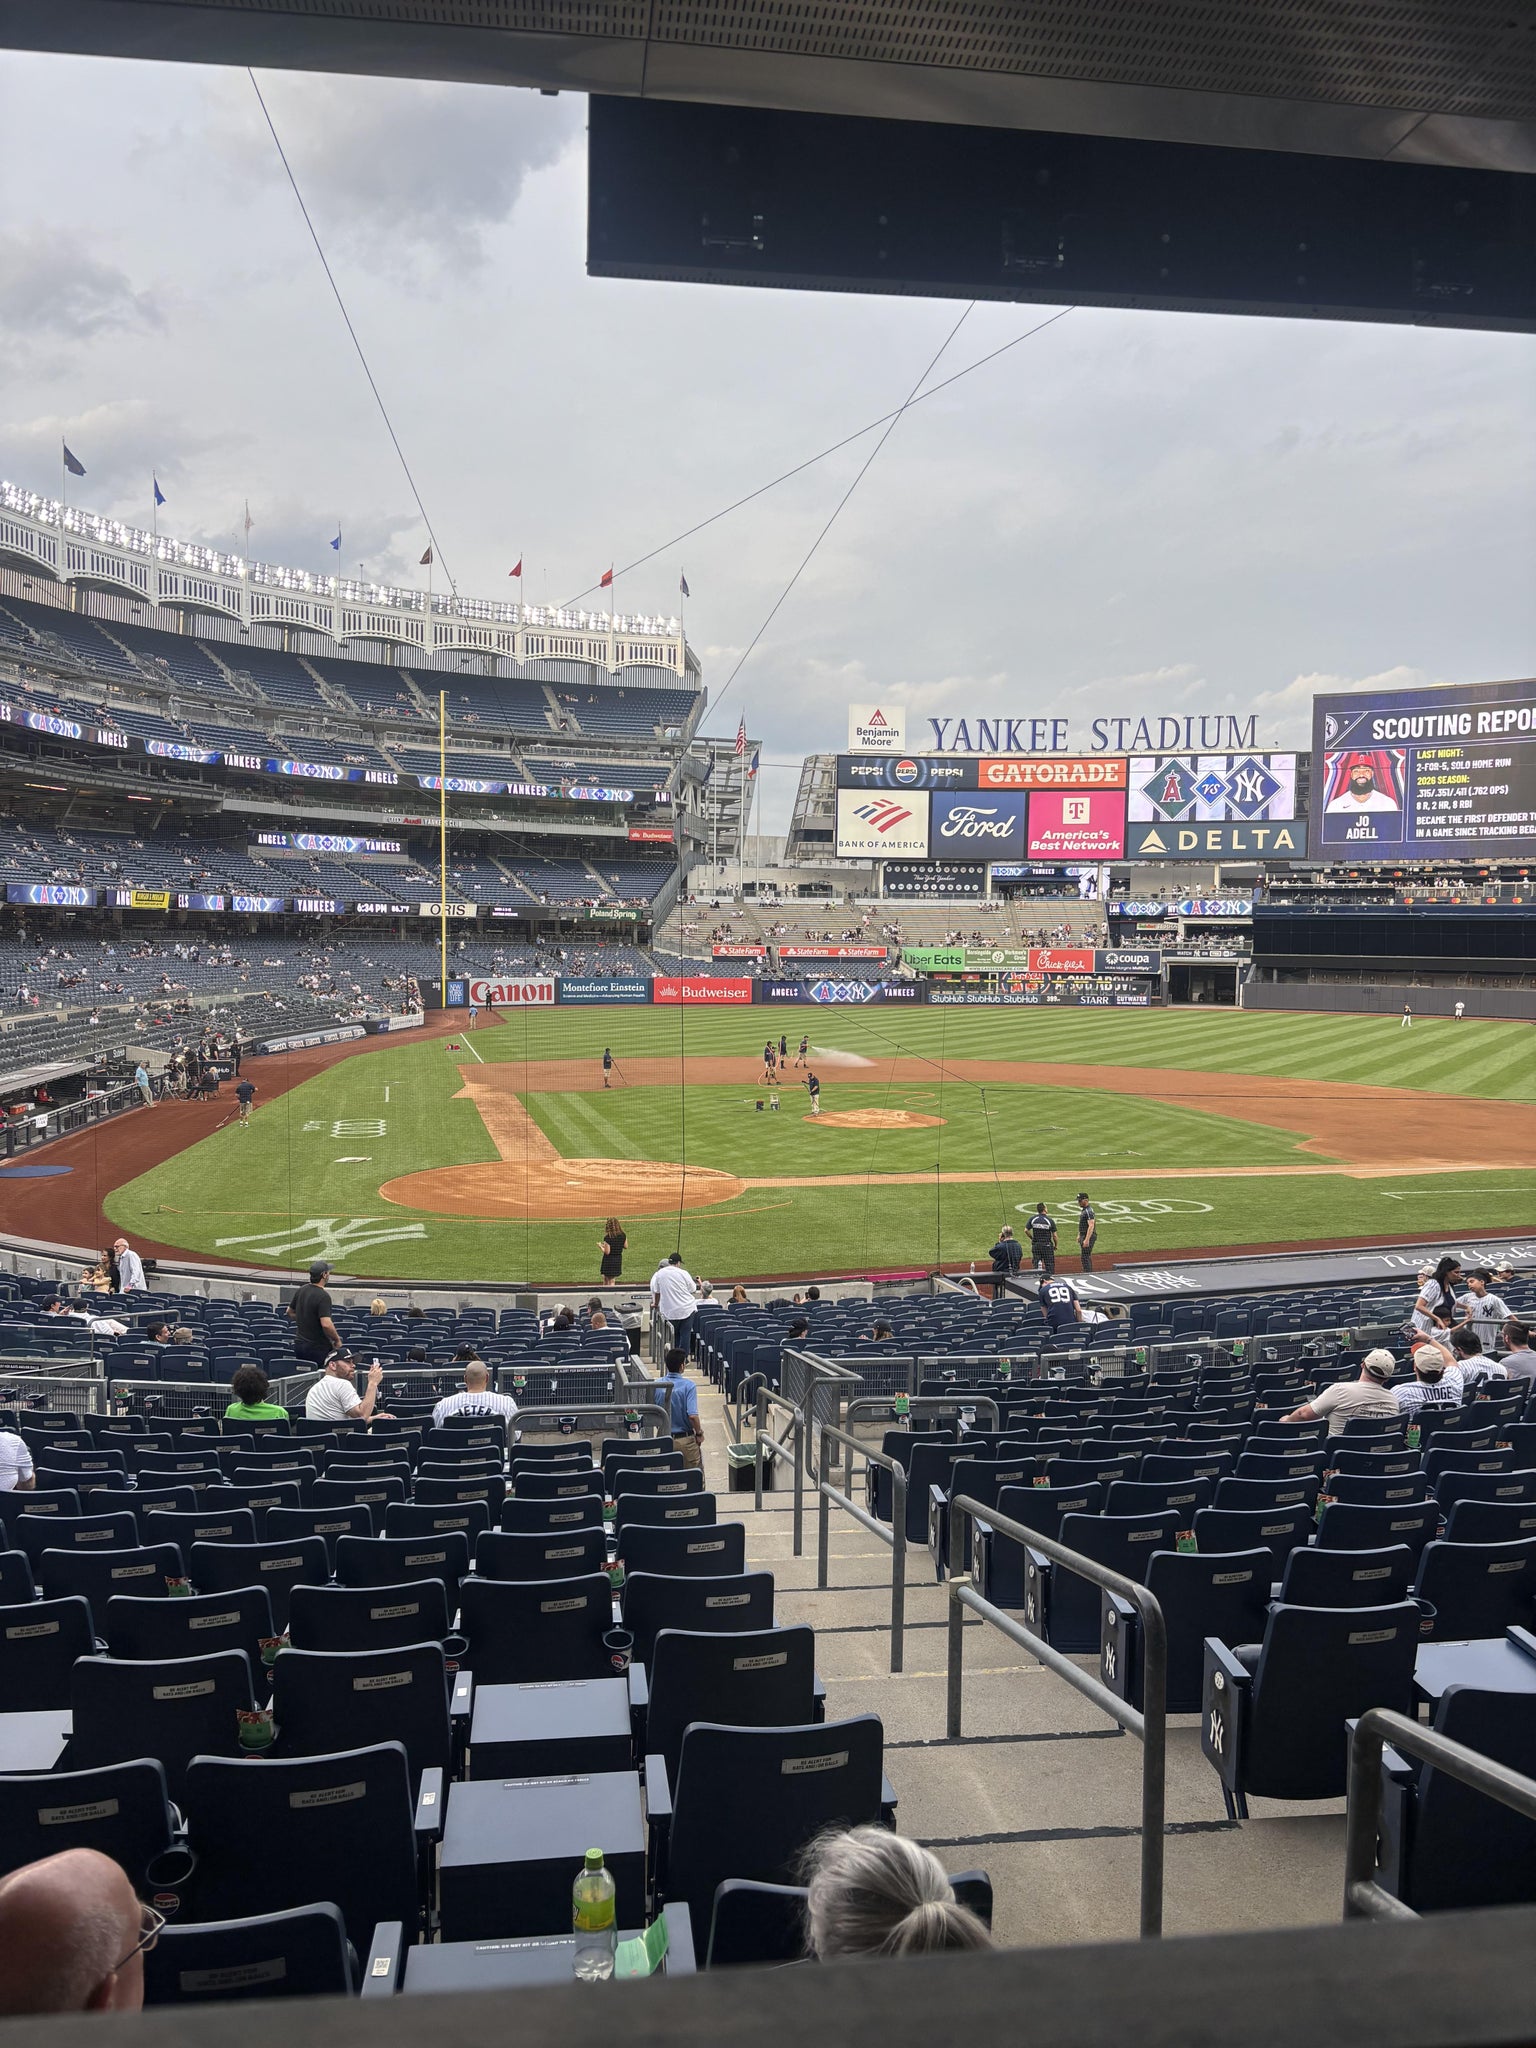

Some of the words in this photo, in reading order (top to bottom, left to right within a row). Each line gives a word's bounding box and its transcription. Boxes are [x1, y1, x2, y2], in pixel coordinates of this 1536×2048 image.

[928, 718, 1069, 751] YANKEE
[1091, 715, 1260, 751] STADIUM
[1372, 714, 1471, 740] SCOUTING
[97, 730, 128, 749] ANGELS
[856, 727, 899, 740] Benjamin
[862, 737, 892, 746] Moore
[1417, 750, 1437, 759] LAST
[1439, 749, 1464, 758] NIGHT:
[224, 754, 261, 770] YANKEES
[1416, 762, 1449, 773] 2-FOR-5,
[1451, 760, 1470, 770] SOLO
[1472, 759, 1493, 769] HOME
[1495, 758, 1511, 767] RUN
[851, 766, 883, 776] PEPSI
[930, 768, 963, 778] PEPSI
[987, 764, 1119, 783] GATORADE
[365, 770, 398, 785] ANGELS
[1437, 775, 1470, 784] SEASON:
[507, 783, 547, 797] YANKEES
[1490, 784, 1509, 796] OPS)
[1416, 801, 1421, 810] 8
[1431, 801, 1437, 810] 2
[1439, 800, 1451, 811] HR,
[1453, 800, 1458, 809] 8
[1459, 799, 1473, 809] RBI
[940, 807, 1017, 839] Ford
[1355, 816, 1369, 827] JO
[1416, 815, 1446, 825] BECAME
[1448, 814, 1463, 824] THE
[1465, 814, 1486, 823] FIRST
[1488, 812, 1528, 822] DEFENDER
[1042, 830, 1110, 841] America's
[1346, 828, 1378, 840] ADELL
[1416, 829, 1424, 838] IN
[1425, 829, 1431, 837] A
[1433, 827, 1453, 837] GAME
[1455, 827, 1477, 836] SINCE
[1478, 826, 1518, 836] TRACKING
[258, 833, 287, 845] ANGELS
[839, 841, 865, 849] BANK
[867, 841, 880, 849] OF
[882, 841, 925, 849] AMERICA
[1179, 829, 1295, 852] DELTA
[365, 841, 401, 852] YANKEES
[1031, 841, 1055, 851] Best
[1057, 841, 1121, 851] Network
[298, 899, 335, 913] YANKEES
[357, 903, 376, 914] 6:34
[376, 903, 388, 914] PM
[430, 903, 466, 916] ORIS
[590, 909, 613, 918] Poland
[614, 910, 637, 920] Spring
[797, 948, 812, 956] State
[812, 948, 829, 956] Farm
[847, 948, 862, 956] State
[905, 953, 932, 965] Uber
[934, 954, 962, 965] Eats
[1036, 953, 1085, 970] Chick-fil-A
[1118, 952, 1149, 966] coupa
[471, 982, 552, 1003] Canon
[562, 983, 608, 992] Montefiore
[610, 983, 645, 992] Einstein
[682, 985, 747, 999] Budweiser
[771, 988, 798, 997] ANGELS
[884, 989, 915, 997] YANKEES
[931, 994, 964, 1003] StubHub
[967, 994, 1000, 1003] StubHub
[1003, 994, 1038, 1003] StubHub
[1080, 996, 1109, 1004] STARR
[1118, 1270, 1171, 1279] NEW
[1122, 1275, 1196, 1285] YORK
[1141, 1281, 1200, 1290] LIFE
[1049, 1287, 1071, 1303] 99
[1423, 1386, 1452, 1402] JUDGE
